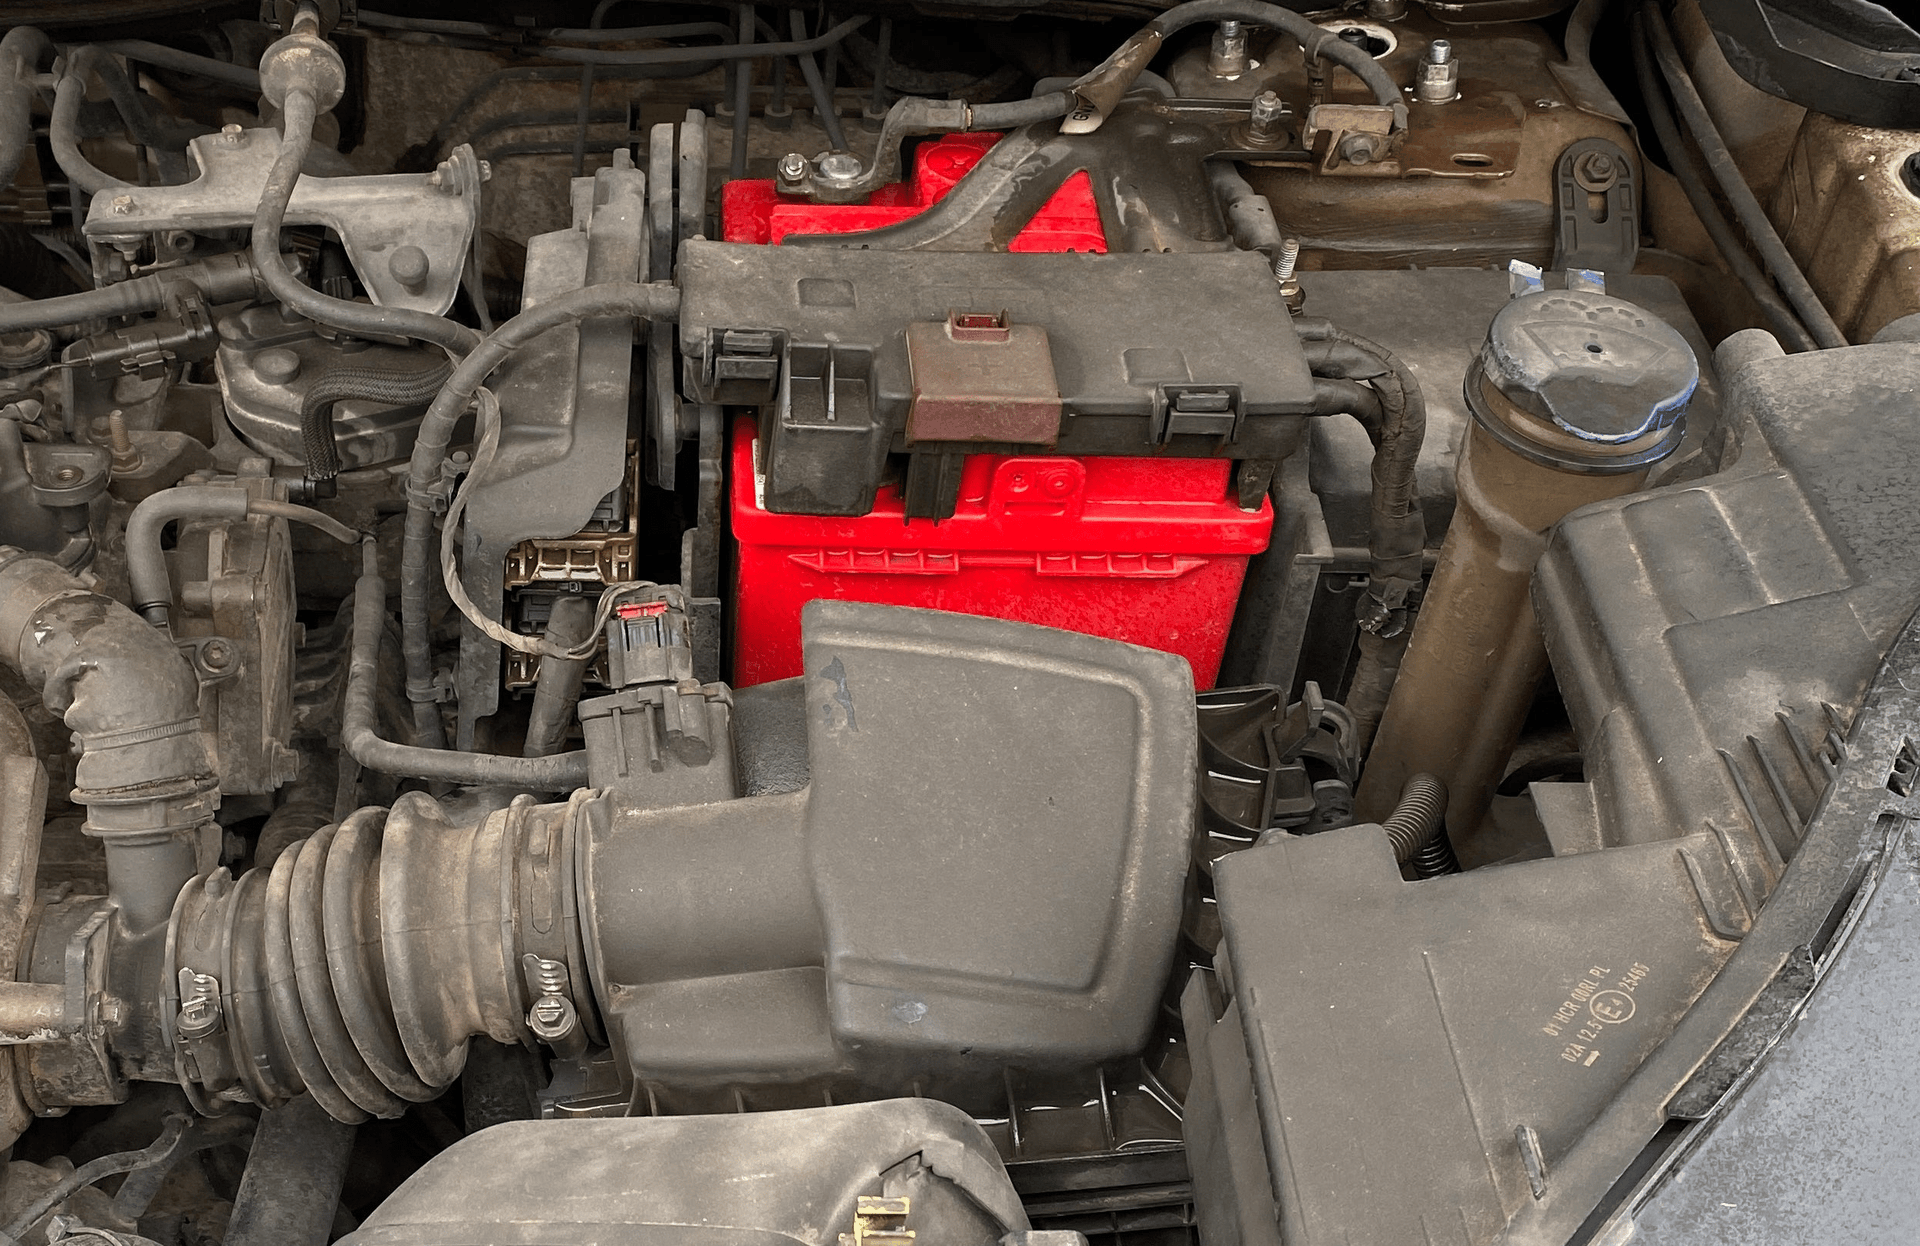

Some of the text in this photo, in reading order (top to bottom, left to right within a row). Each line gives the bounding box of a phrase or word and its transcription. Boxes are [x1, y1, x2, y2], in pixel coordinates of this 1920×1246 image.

[1589, 965, 1611, 979] PL
[1552, 1001, 1581, 1024] HCR
[1542, 1021, 1563, 1036] 01
[1561, 1042, 1587, 1063] 02A
[1576, 1020, 1603, 1043] 12.5
